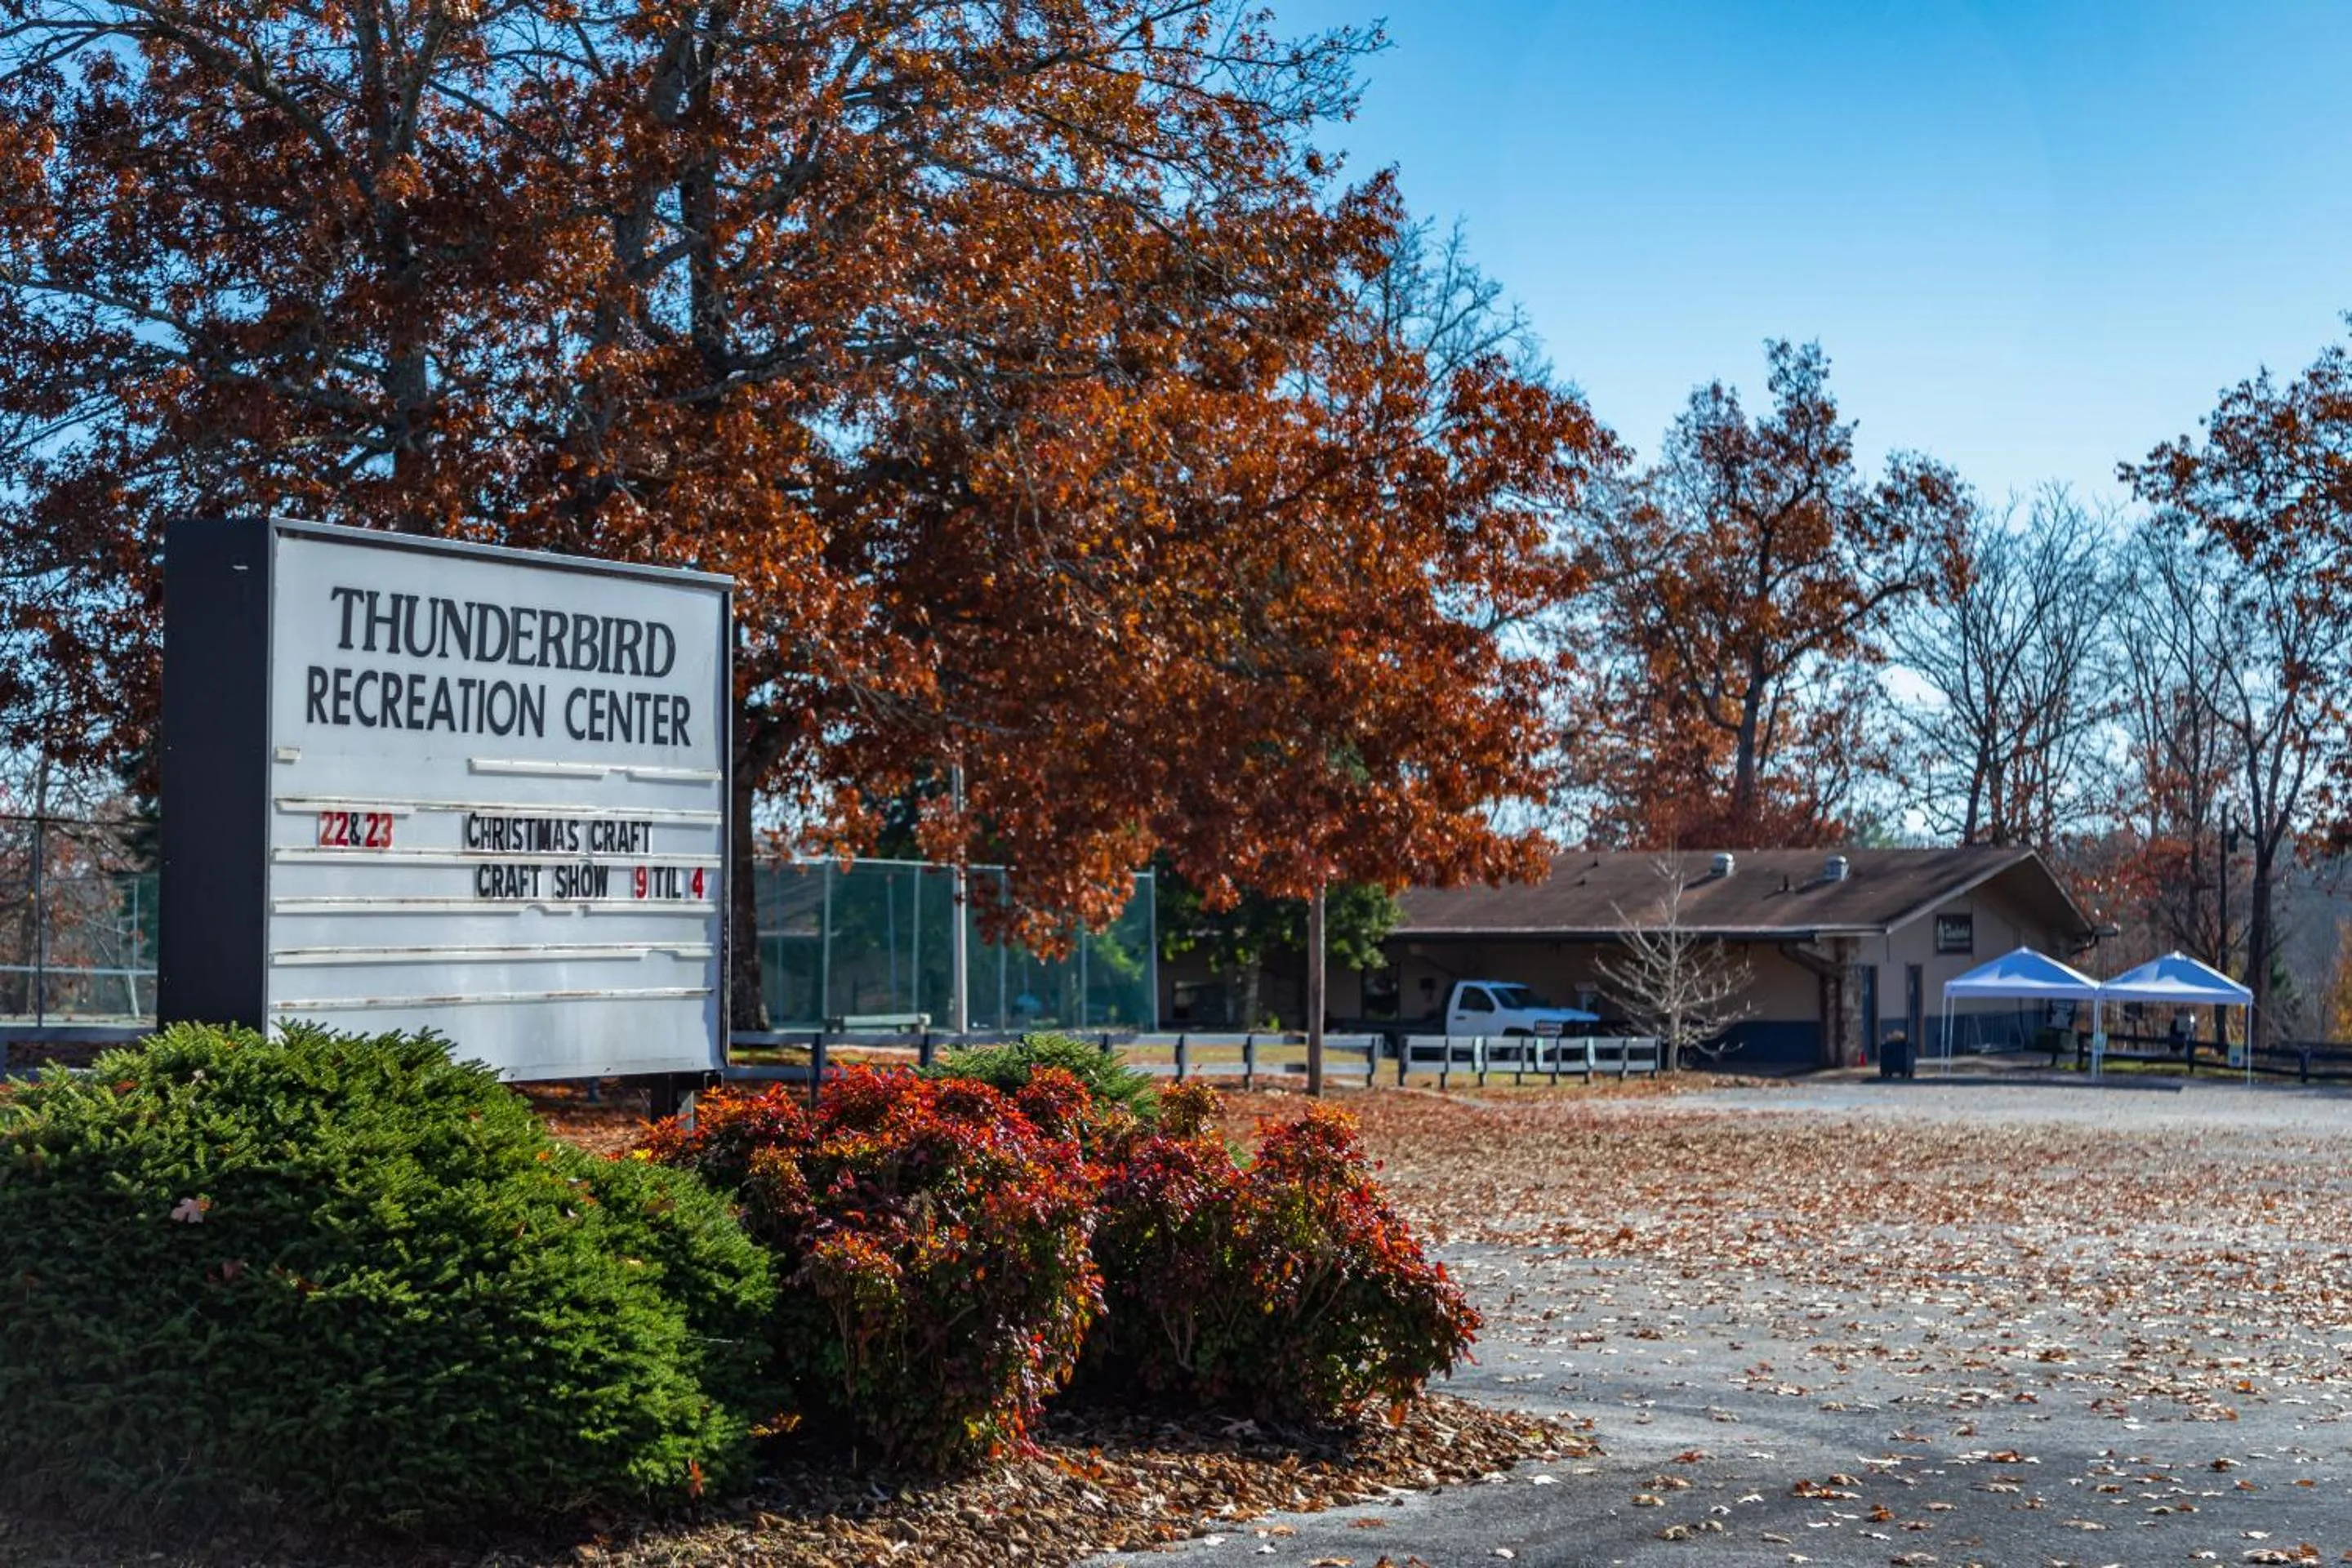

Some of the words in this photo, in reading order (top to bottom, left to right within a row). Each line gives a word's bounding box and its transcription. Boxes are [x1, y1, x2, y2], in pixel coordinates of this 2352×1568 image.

[331, 586, 676, 678] THUNDERBIRD
[306, 666, 546, 738] RECREATION
[564, 687, 692, 747] CENTER
[467, 812, 579, 852] CHRISTMAS
[590, 820, 653, 853] CRAFT
[477, 862, 541, 898] CRAFT
[555, 863, 609, 898] SHOW
[635, 864, 648, 898] 9
[653, 866, 681, 899] TIL
[691, 866, 703, 899] 4
